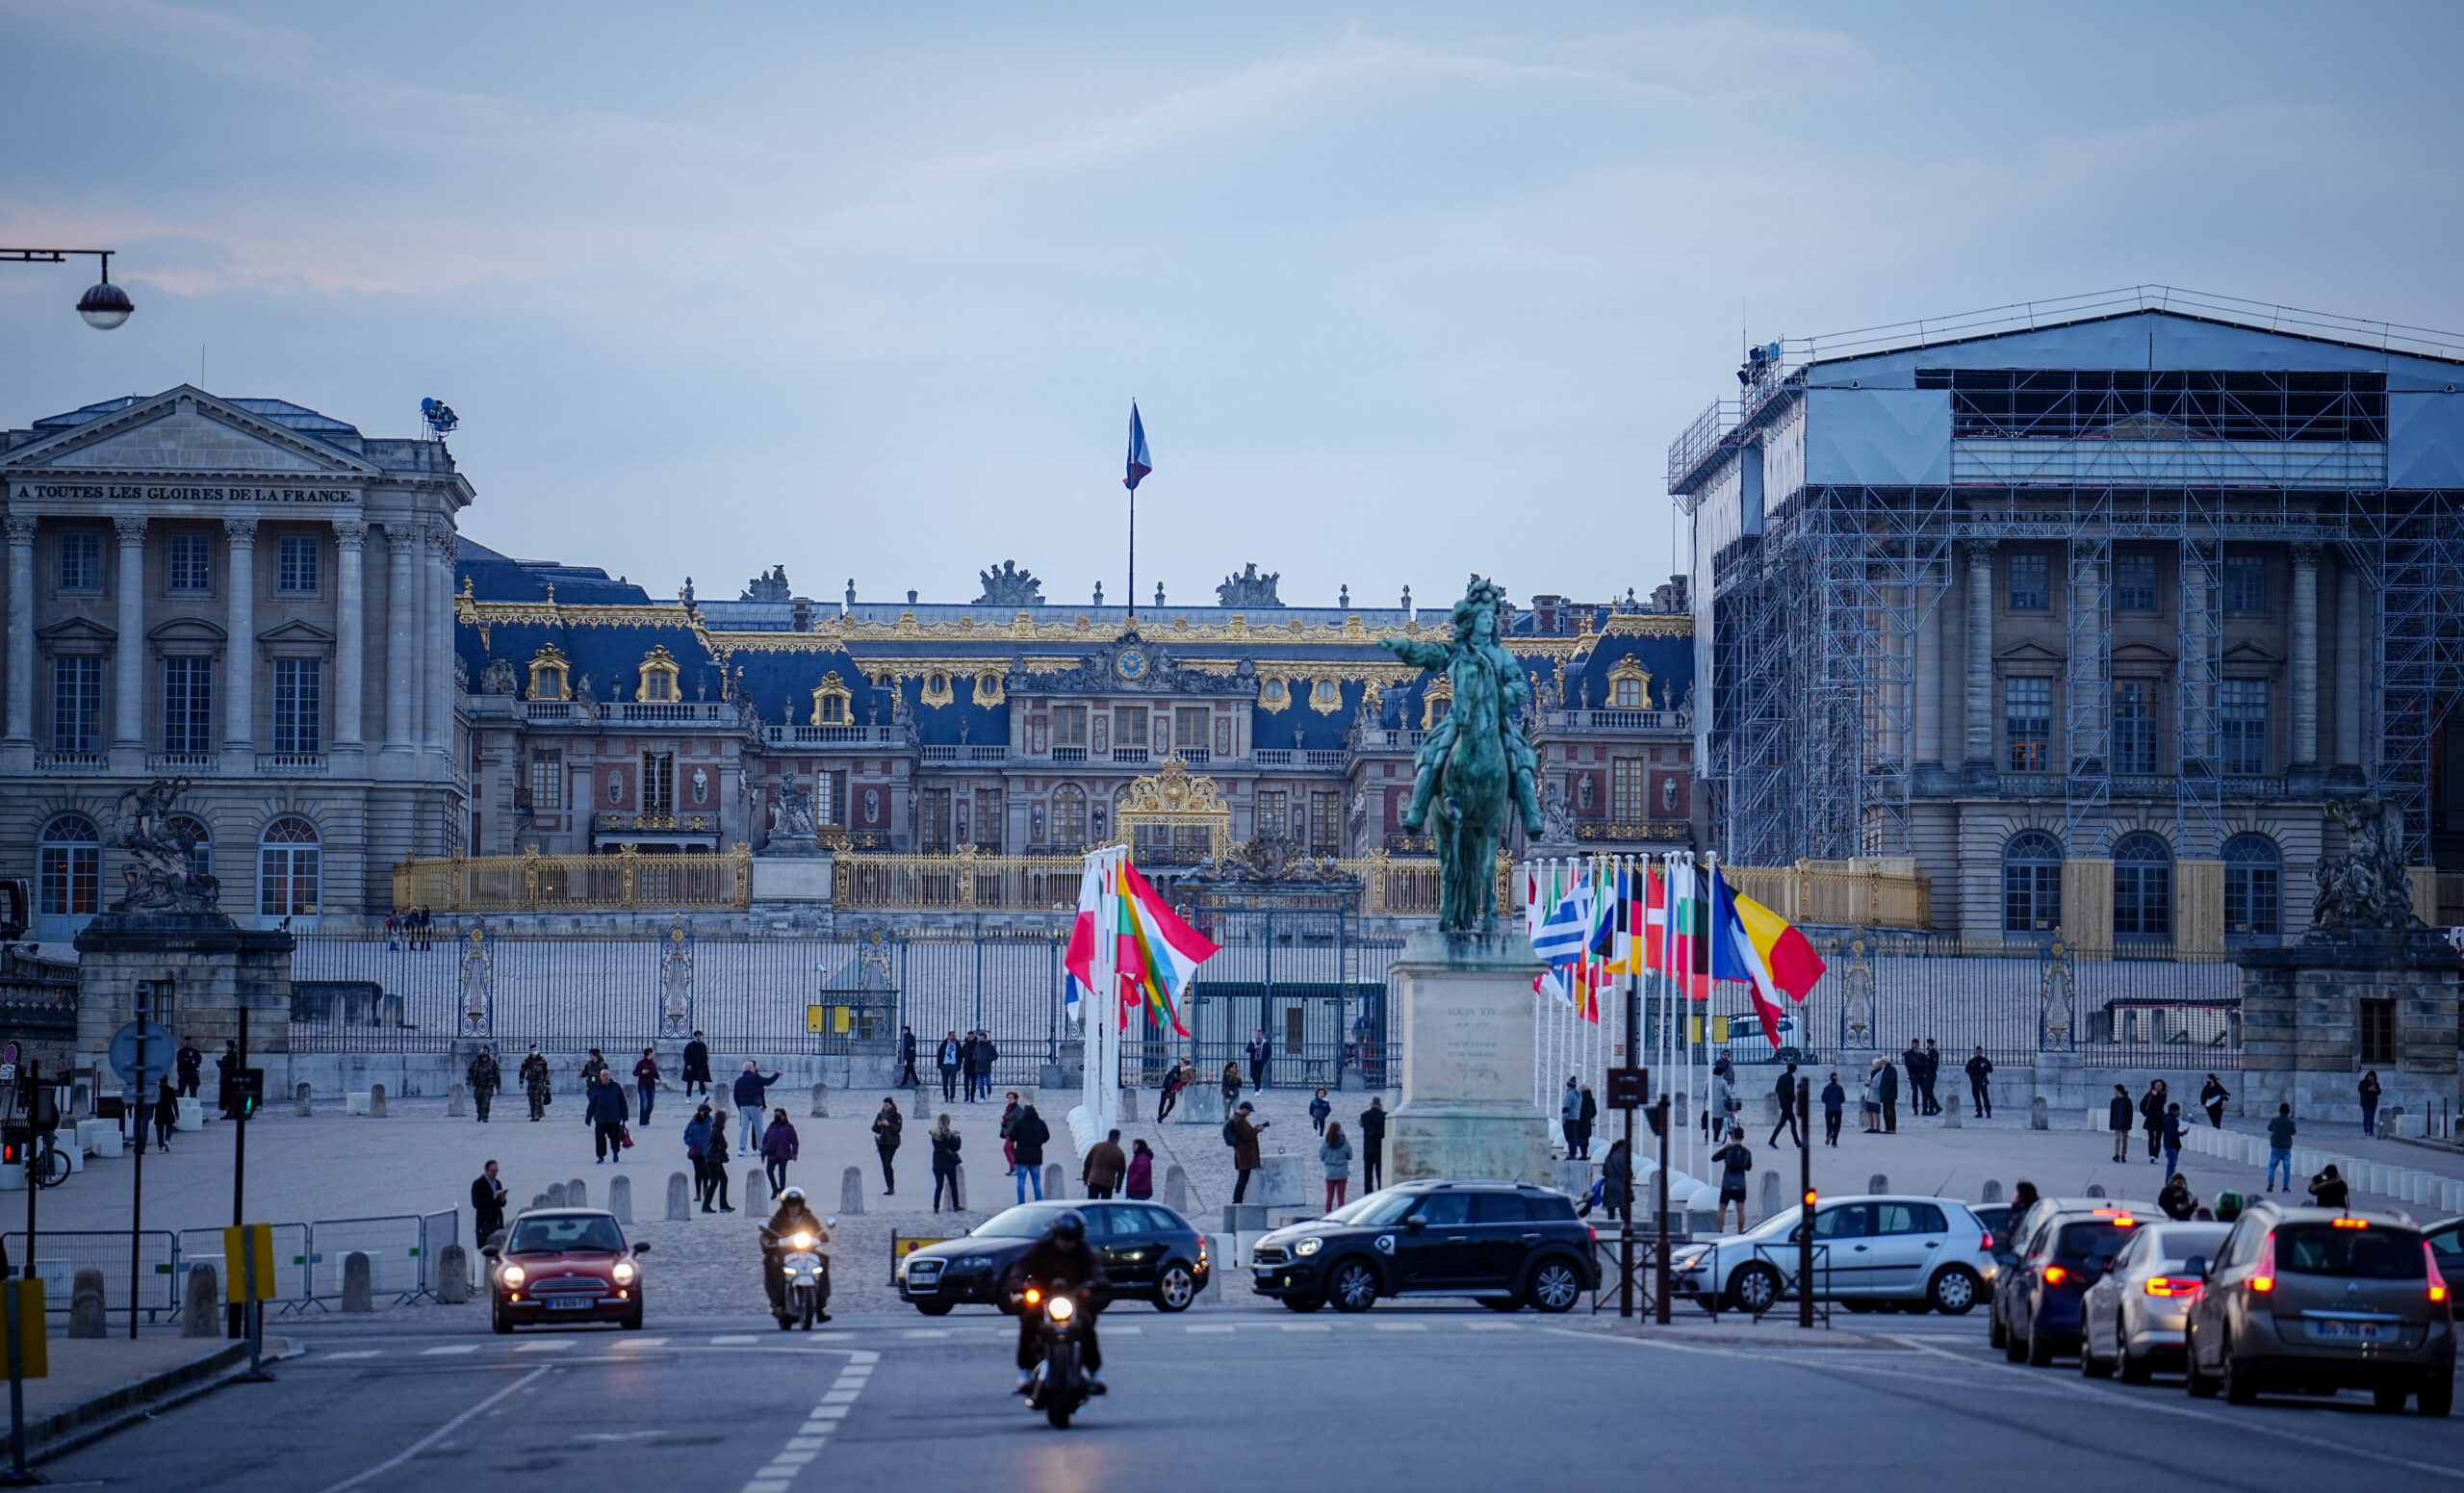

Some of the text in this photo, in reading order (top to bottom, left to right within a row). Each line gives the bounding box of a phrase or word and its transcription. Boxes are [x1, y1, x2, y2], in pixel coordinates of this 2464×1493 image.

[17, 485, 355, 502] A TOUTES LES GLOIRES DE LA FRANCE.
[1996, 510, 2062, 522] TOUTES
[1448, 1007, 1498, 1016] LOUIS XIV
